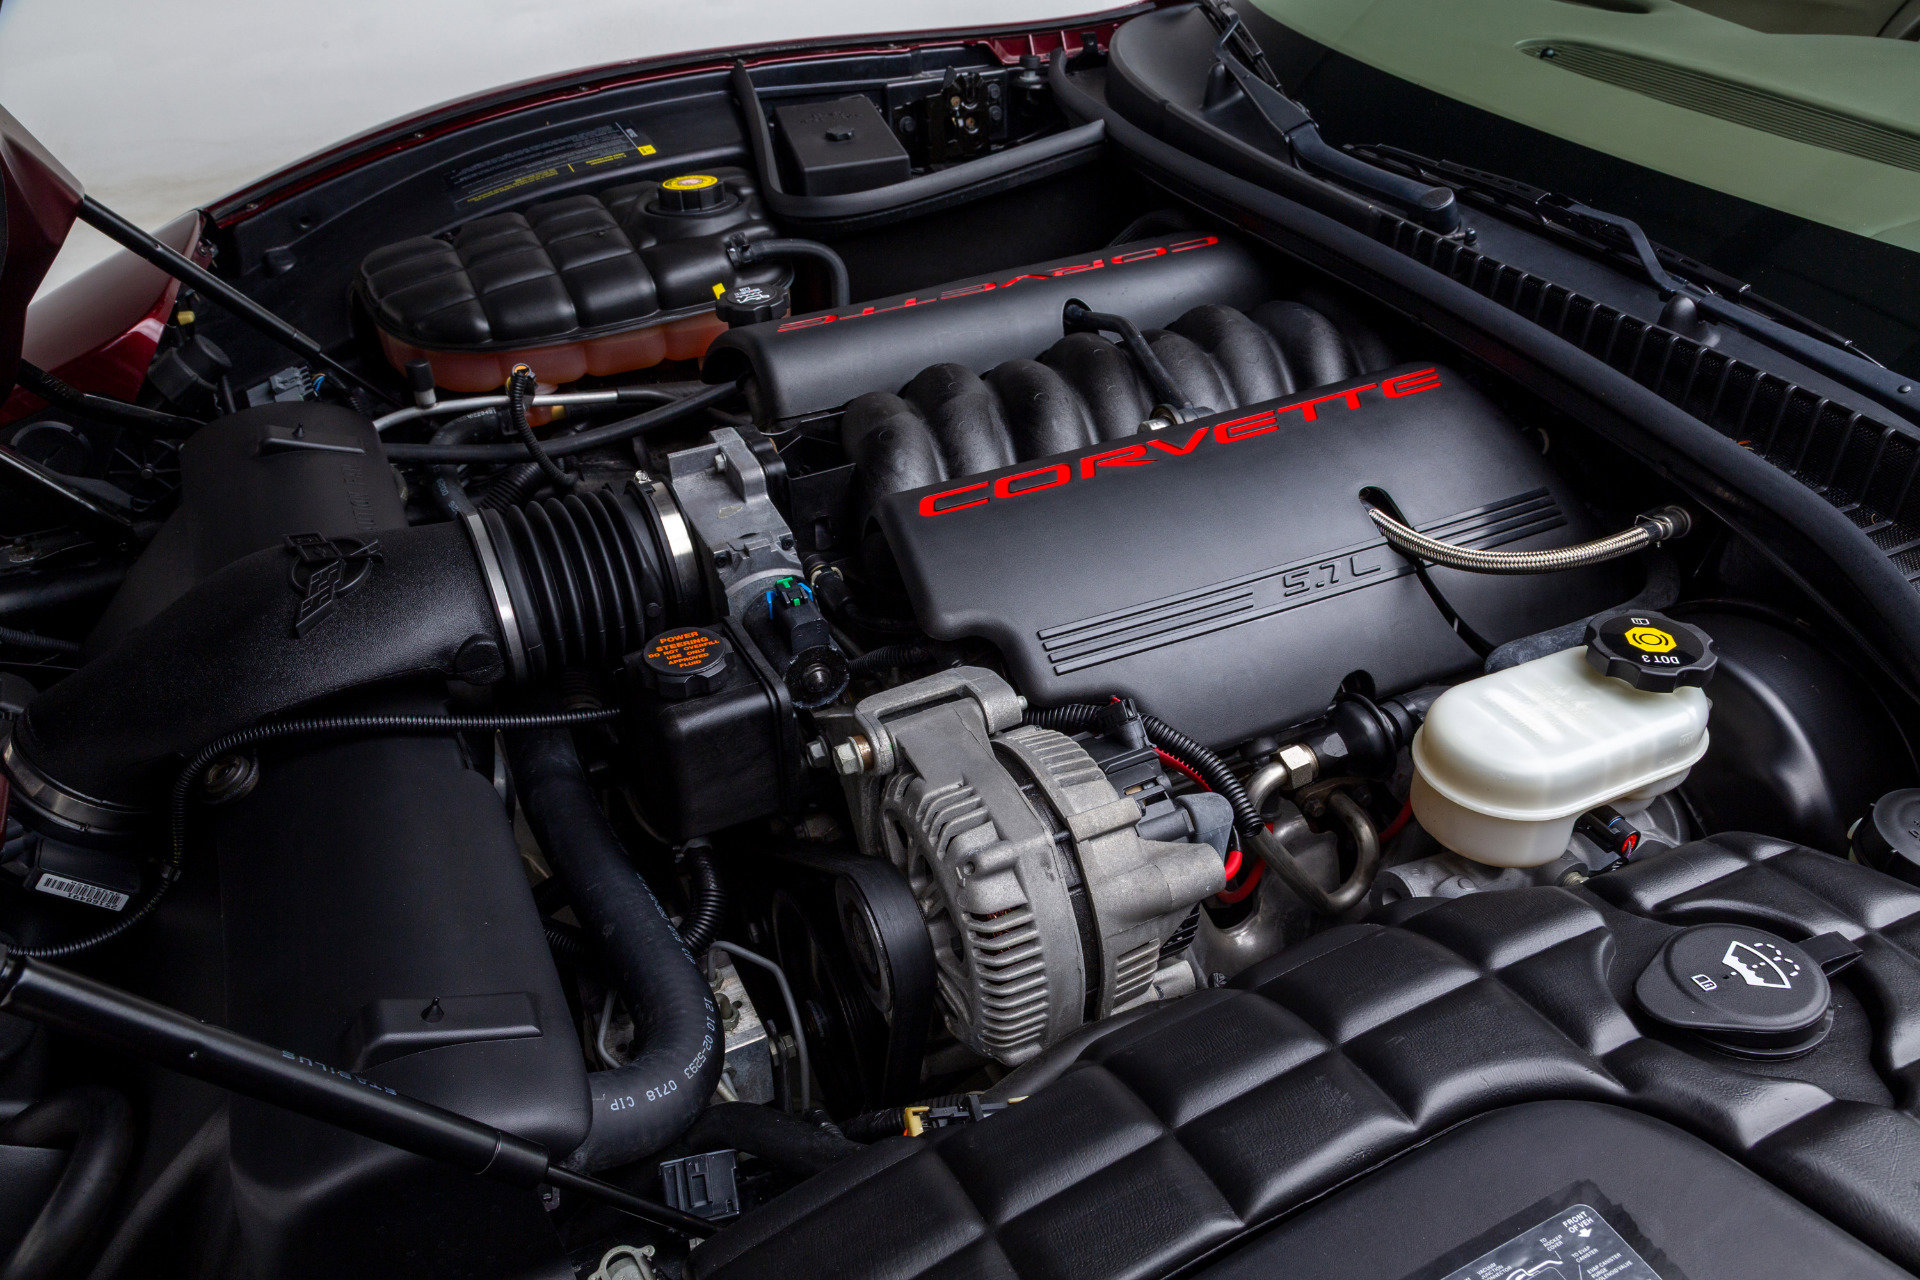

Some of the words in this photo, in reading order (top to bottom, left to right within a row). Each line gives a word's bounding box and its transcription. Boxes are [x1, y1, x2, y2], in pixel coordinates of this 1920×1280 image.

[777, 236, 1219, 333] CORVETTE
[919, 367, 1442, 517] CORVETTE
[1282, 553, 1381, 597] 5.7L
[655, 636, 709, 652] STEERING
[659, 631, 699, 644] POWER
[662, 648, 679, 656] NOT
[683, 639, 720, 651] OVERFILL
[686, 647, 706, 656] ONLY
[668, 652, 709, 666] APPROVED
[679, 659, 702, 668] FLUID
[1641, 654, 1651, 663] 3
[1653, 655, 1680, 665] DOT
[645, 1079, 678, 1102] 0718
[610, 1096, 635, 1111] CIP
[1562, 1210, 1588, 1228] FRONT
[1568, 1224, 1579, 1234] OF
[1577, 1216, 1595, 1228] VEH
[1542, 1234, 1563, 1248] ROCKER
[1546, 1240, 1563, 1252] COVER
[1575, 1248, 1599, 1263] CANISTER
[1578, 1245, 1590, 1255] EVAP
[1476, 1262, 1496, 1276] VACUUM
[1586, 1265, 1599, 1275] EVAP
[1598, 1252, 1621, 1268] CANISTER
[1617, 1260, 1633, 1271] VALVE
[1590, 1267, 1608, 1279] PURGE
